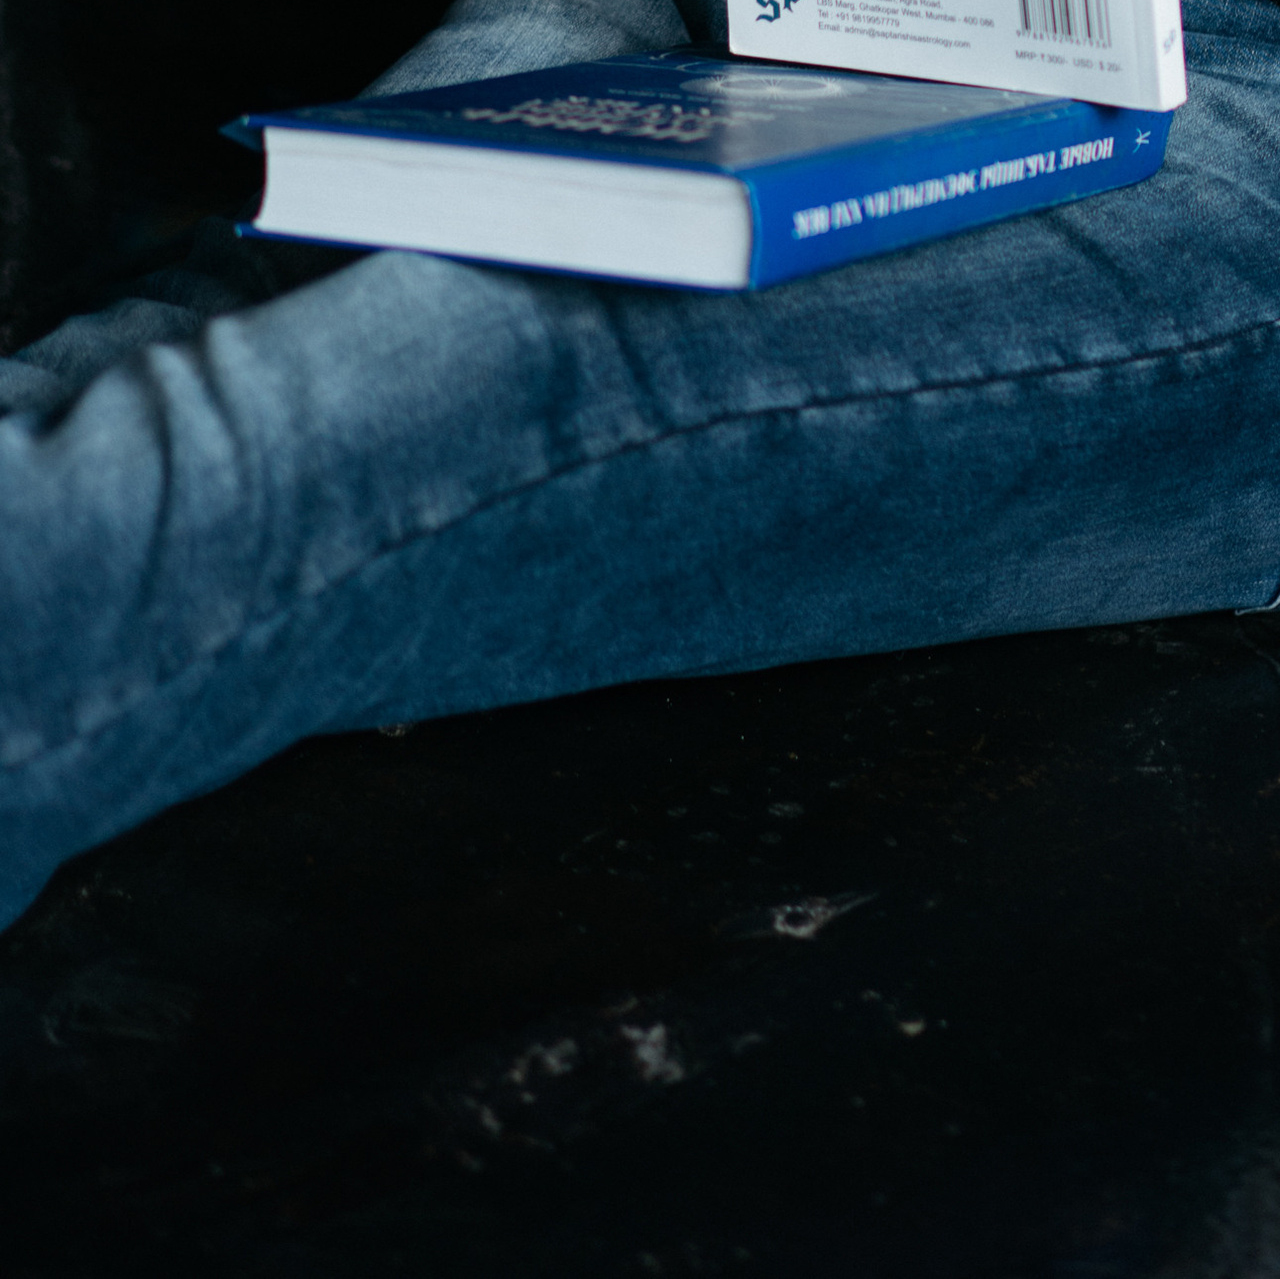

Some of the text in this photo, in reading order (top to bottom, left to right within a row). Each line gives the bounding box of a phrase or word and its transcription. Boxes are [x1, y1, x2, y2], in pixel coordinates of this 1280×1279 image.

[835, 11, 850, 21] +91
[859, 2, 899, 16] Ghatkopar
[925, 11, 956, 22] Mumbai
[1060, 136, 1114, 170] НОВЫЕ
